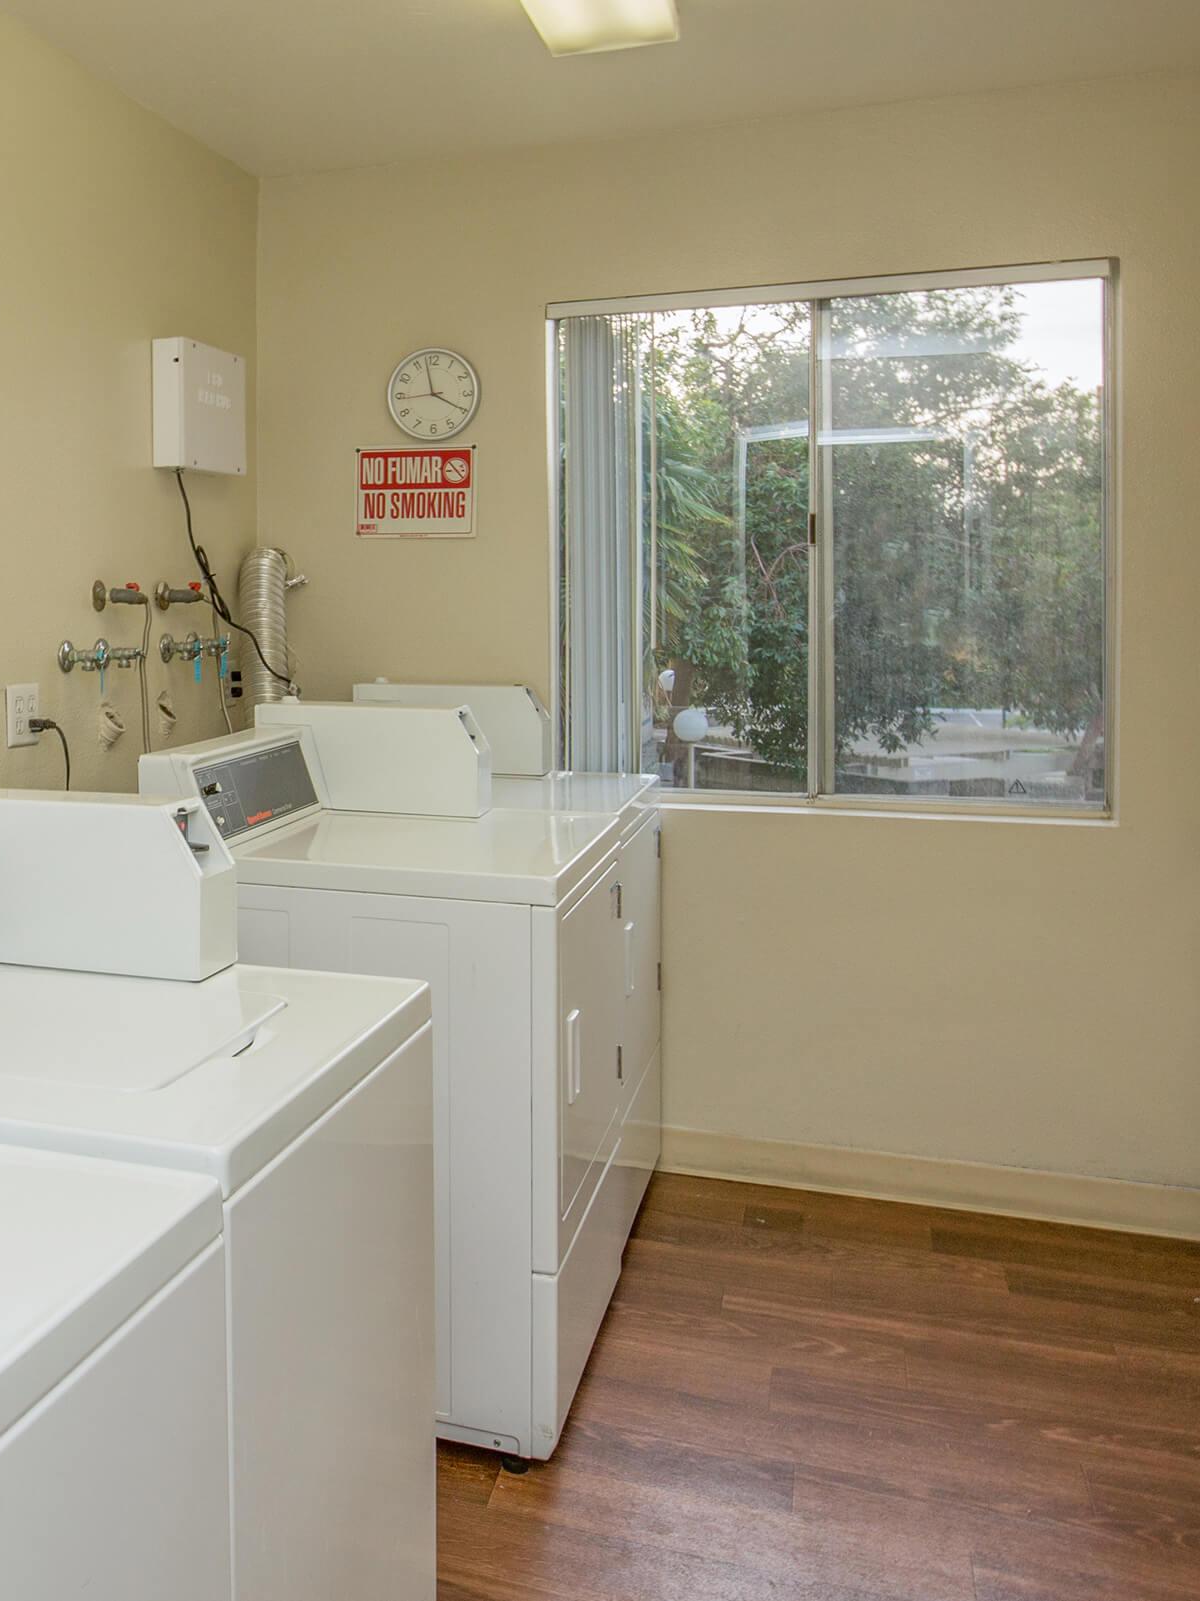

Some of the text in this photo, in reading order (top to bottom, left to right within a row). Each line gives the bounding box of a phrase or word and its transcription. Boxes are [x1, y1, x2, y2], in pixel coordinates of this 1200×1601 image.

[428, 355, 440, 366] 12
[449, 360, 454, 369] 1
[413, 361, 422, 371] 11
[399, 373, 411, 385] 10
[457, 373, 468, 381] 2
[400, 408, 410, 417] 8
[412, 419, 422, 429] 7
[430, 424, 437, 434] 6
[446, 419, 455, 429] 5
[362, 457, 442, 485] NO FUMAR
[364, 491, 465, 519] NO SMOKING
